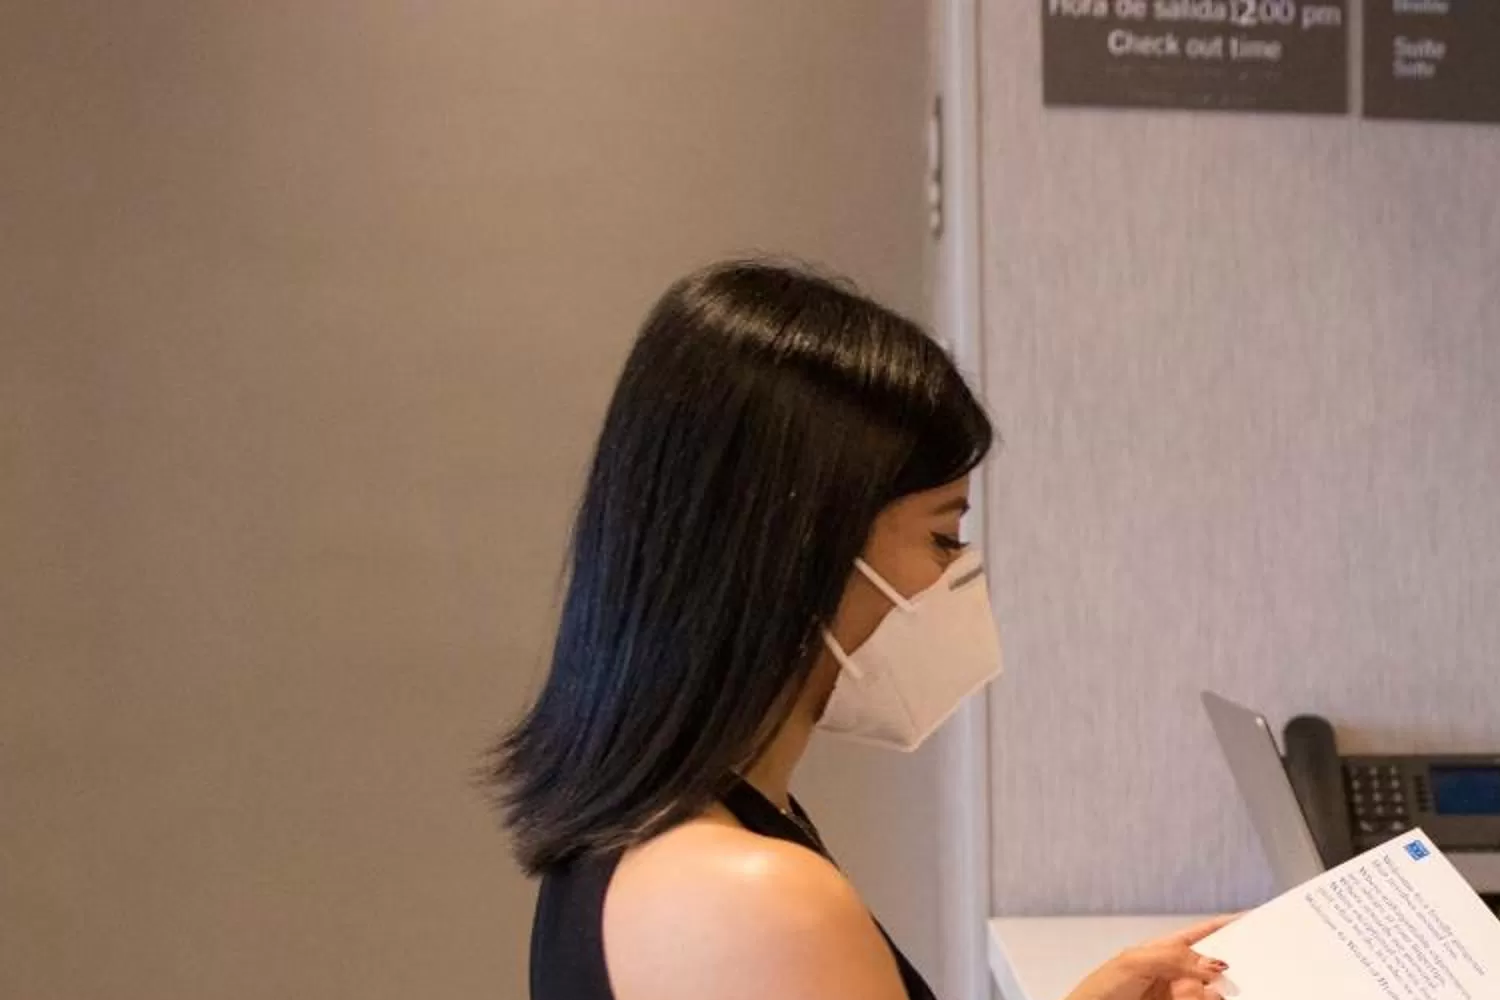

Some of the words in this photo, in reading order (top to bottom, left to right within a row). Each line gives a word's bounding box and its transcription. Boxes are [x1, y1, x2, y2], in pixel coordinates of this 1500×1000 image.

[1107, 29, 1179, 57] Check
[1186, 36, 1223, 58] out
[1230, 36, 1282, 61] time
